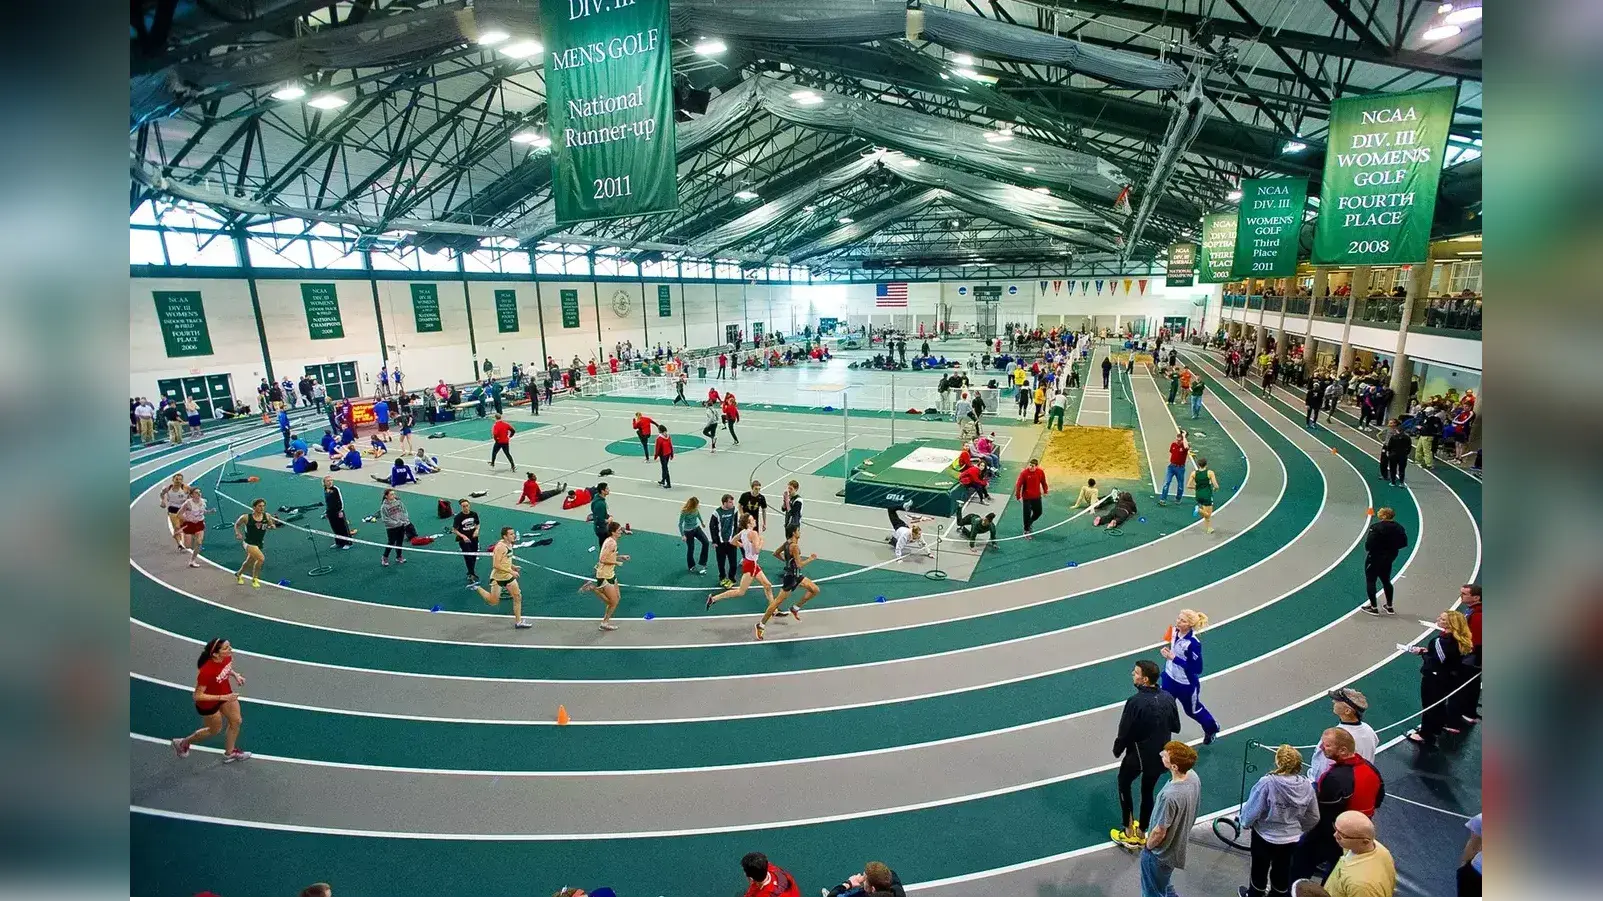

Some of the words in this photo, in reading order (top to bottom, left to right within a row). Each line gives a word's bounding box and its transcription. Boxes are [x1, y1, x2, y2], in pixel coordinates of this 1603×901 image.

[552, 42, 606, 71] MEN'S
[608, 29, 658, 59] GOLF
[569, 85, 643, 119] National
[1361, 106, 1417, 125] NCAA
[565, 118, 655, 148] Runner-up
[1351, 132, 1390, 149] DIV.
[1394, 130, 1416, 146] III
[1337, 147, 1430, 168] WOMEN'S
[1354, 169, 1406, 187] GOLF
[593, 175, 632, 199] 2011
[1257, 186, 1289, 196] NCAA
[1254, 200, 1276, 209] DIV.
[1278, 199, 1290, 208] III
[1338, 192, 1415, 209] FOURTH
[1247, 216, 1294, 226] WOMEN'S
[1343, 211, 1402, 227] PLACE
[1255, 227, 1282, 235] GOLF
[1254, 238, 1280, 247] Third
[1348, 240, 1390, 254] 2008
[1253, 249, 1278, 257] Place
[1252, 262, 1274, 271] 2011
